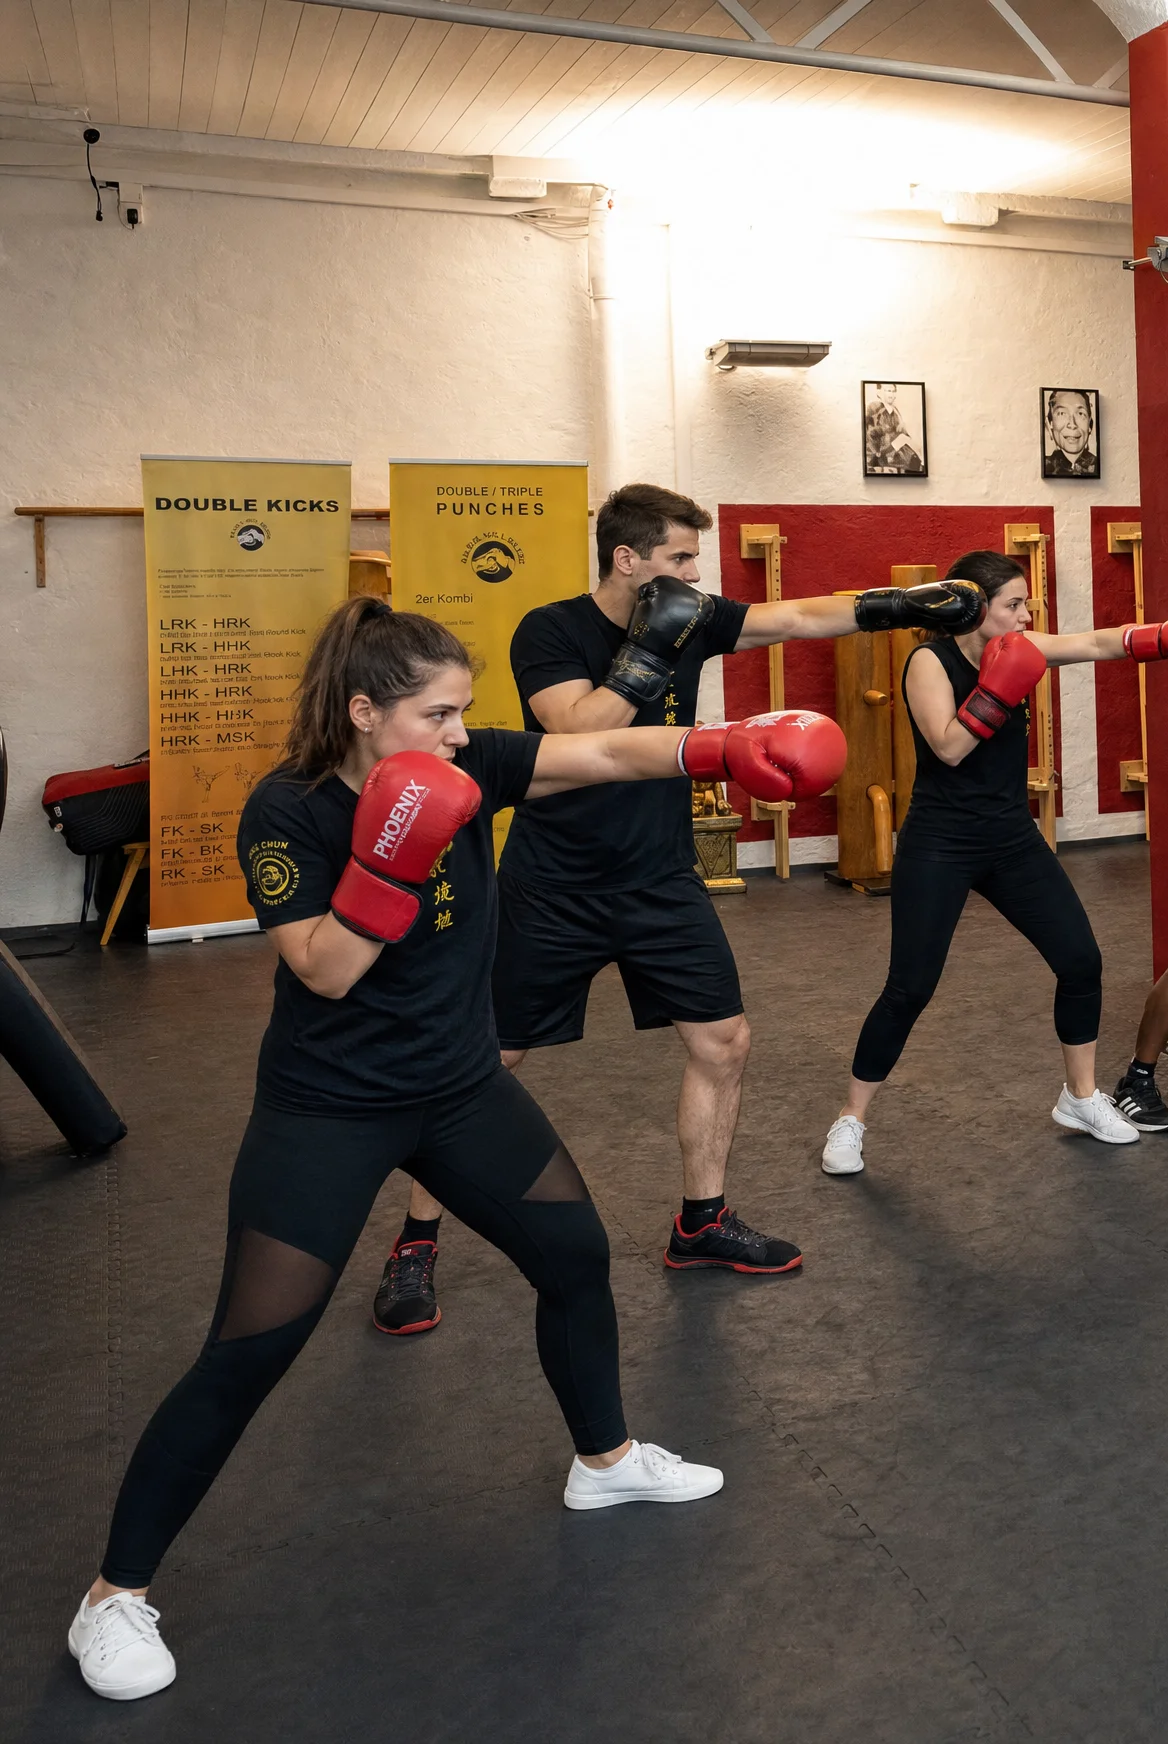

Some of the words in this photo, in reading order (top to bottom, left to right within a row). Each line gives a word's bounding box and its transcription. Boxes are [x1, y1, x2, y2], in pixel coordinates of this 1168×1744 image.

[437, 486, 489, 497] DOUBLE
[500, 487, 543, 497] TRIPLE
[155, 497, 258, 511] DOUBLE
[267, 499, 339, 512] KICKS
[436, 502, 544, 516] PUNCHES
[415, 594, 434, 604] 2er
[437, 593, 473, 604] Kombi
[160, 618, 197, 630] LRK
[213, 617, 250, 629] HRK
[160, 641, 197, 654] LRK
[214, 640, 251, 652] HHK
[160, 664, 198, 677] LHK
[214, 663, 252, 675] HRK
[160, 688, 199, 700] HHK
[215, 685, 253, 698] HRK
[160, 711, 200, 724] HHK
[161, 734, 200, 747] HRK
[216, 731, 255, 744] MSK
[372, 778, 427, 860] PHOENIX
[161, 825, 184, 838] FK
[200, 822, 224, 835] SK
[161, 847, 184, 860] FK
[200, 843, 224, 856] BK
[261, 840, 289, 850] CHUN
[161, 868, 186, 881] RK
[202, 864, 225, 876] SK
